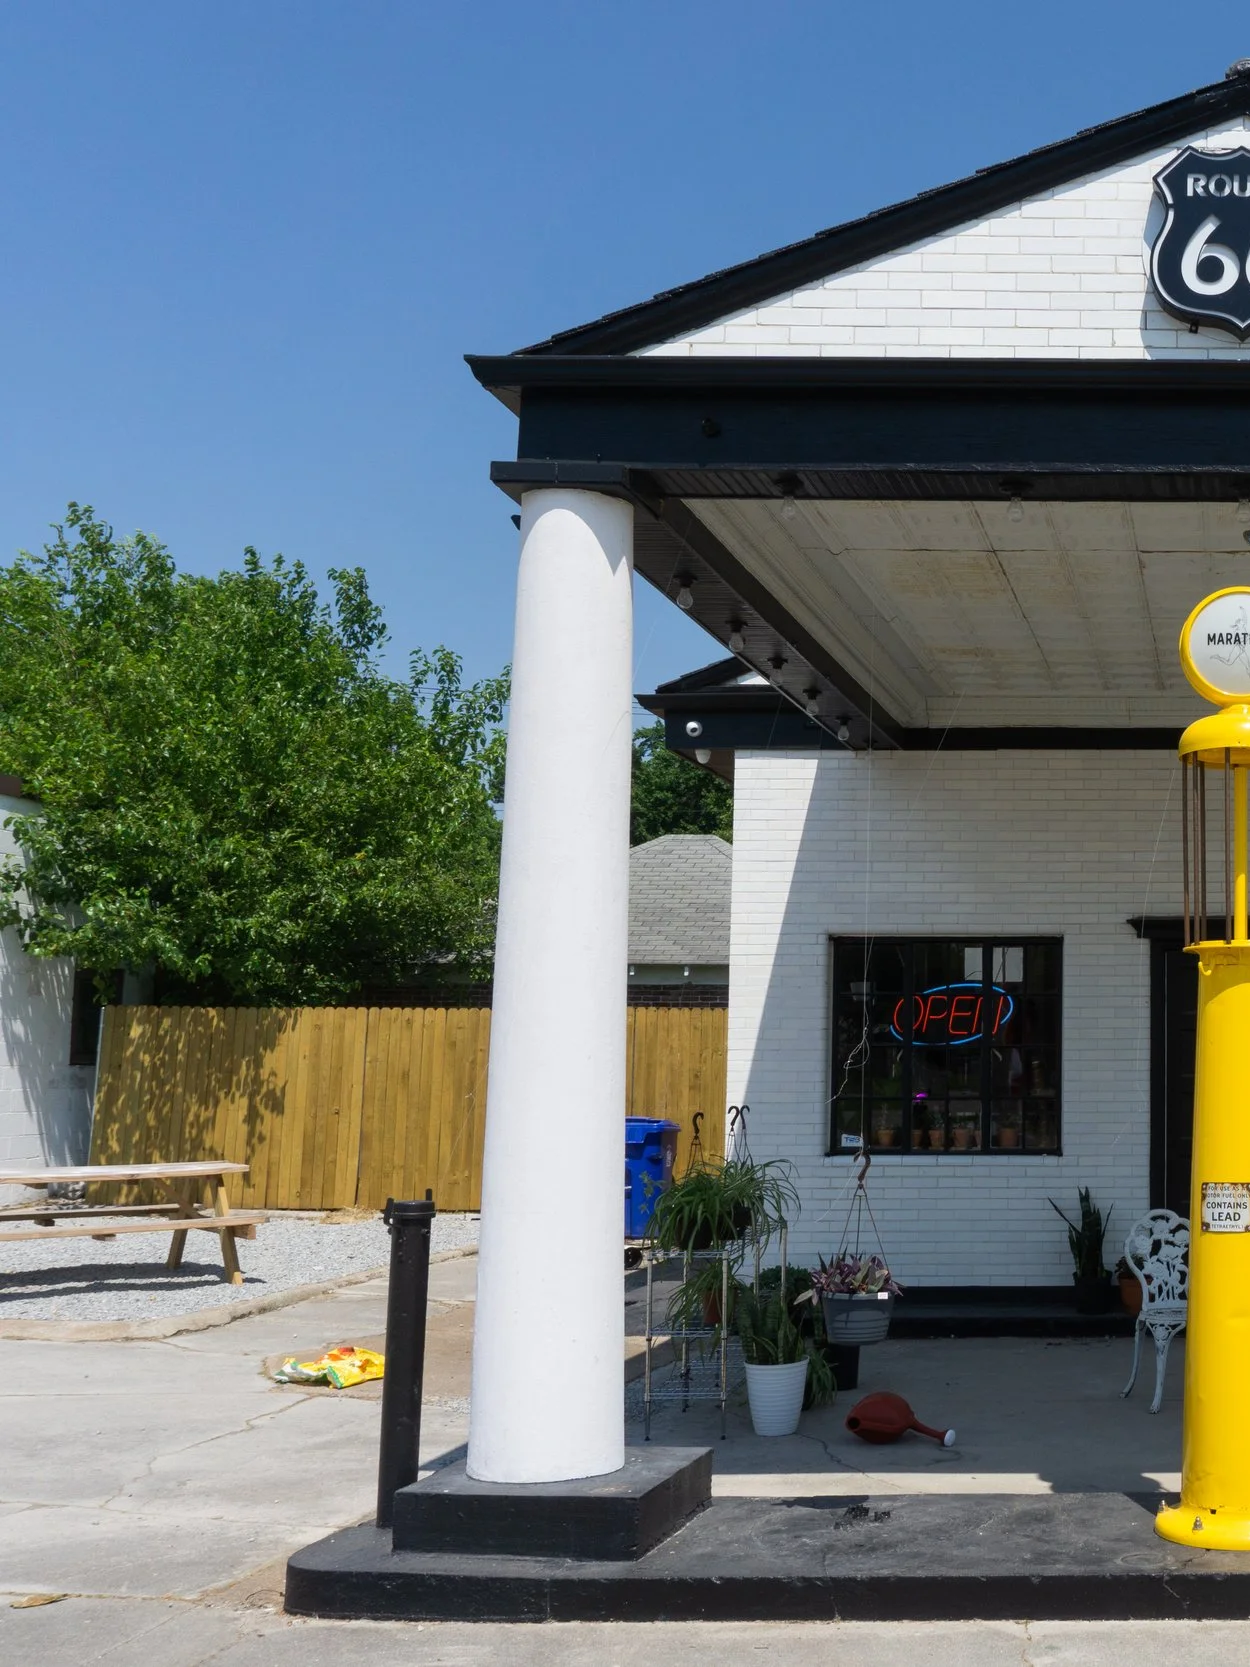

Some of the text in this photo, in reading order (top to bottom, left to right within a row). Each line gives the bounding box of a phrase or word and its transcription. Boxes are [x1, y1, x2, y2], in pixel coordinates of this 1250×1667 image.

[893, 995, 1004, 1035] OPEN
[1206, 1201, 1248, 1209] CONTAINS
[1211, 1212, 1241, 1221] LEAD
